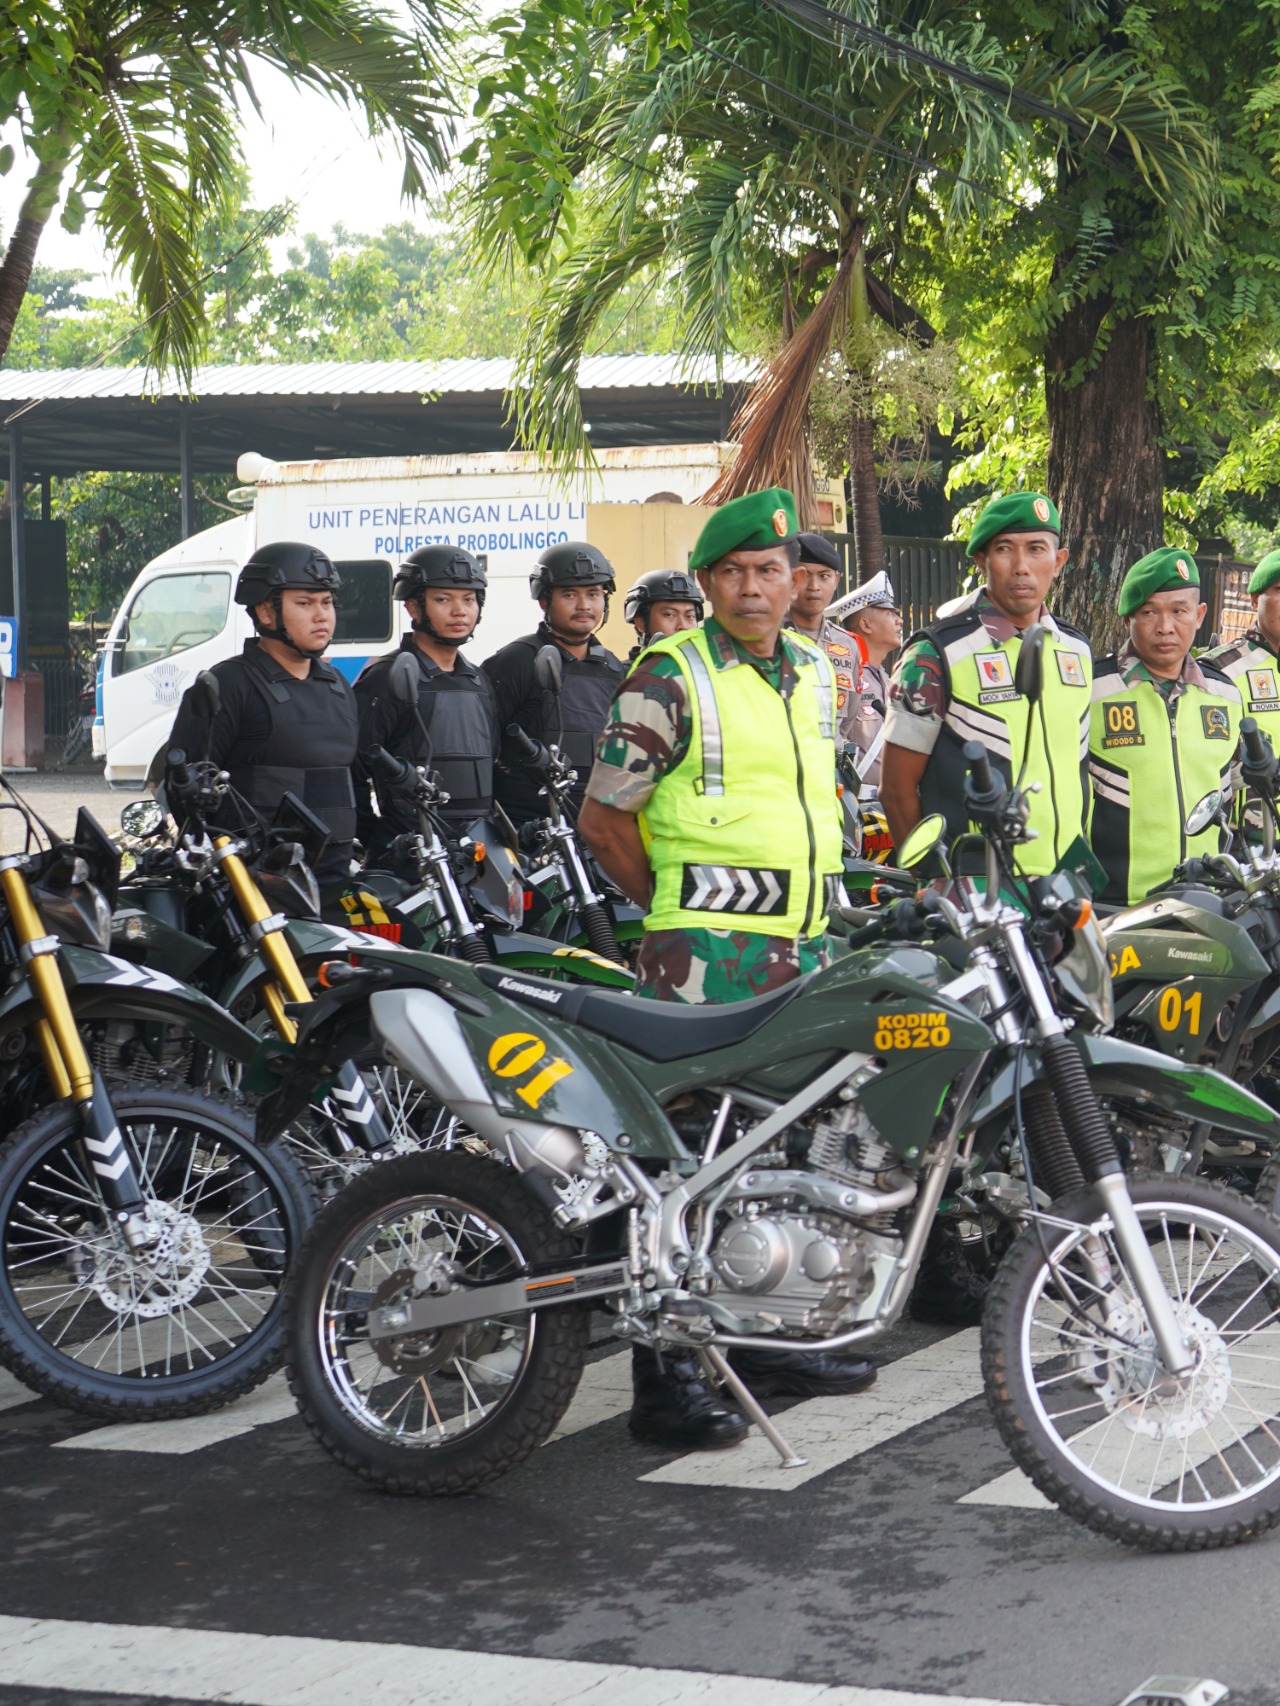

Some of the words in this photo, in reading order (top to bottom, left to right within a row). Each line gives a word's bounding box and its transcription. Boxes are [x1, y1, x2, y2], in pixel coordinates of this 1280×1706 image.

[308, 511, 354, 529] UNIT
[359, 505, 501, 527] PENERANGAN
[508, 502, 561, 522] LALU
[457, 531, 569, 551] PROBOLINGGO
[1108, 705, 1136, 732] 08
[1256, 703, 1279, 711] NOVAN
[1105, 738, 1135, 747] WIDODO
[1137, 736, 1143, 744] B
[1167, 947, 1213, 963] Kawasaki
[498, 976, 563, 1004] Kawasaki
[877, 1012, 947, 1031] KODIM
[1160, 987, 1203, 1036] 01
[874, 1026, 951, 1051] 0820
[488, 1032, 575, 1110] 01
